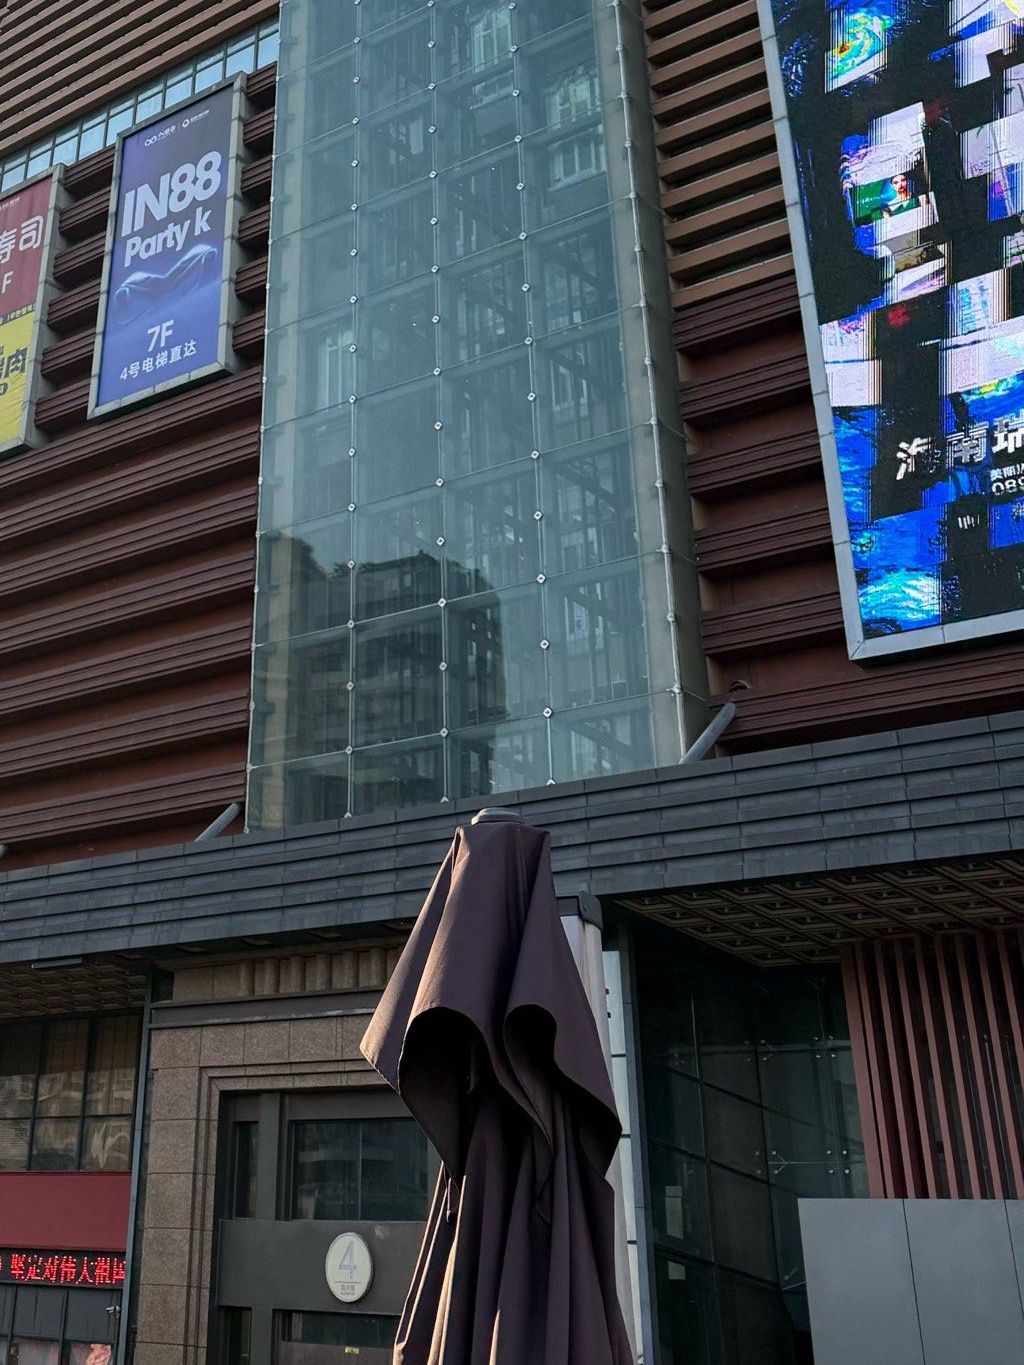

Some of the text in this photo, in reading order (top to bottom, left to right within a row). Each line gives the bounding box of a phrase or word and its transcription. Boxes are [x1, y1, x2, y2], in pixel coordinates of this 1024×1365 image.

[122, 151, 221, 237] IN88
[124, 206, 212, 268] Party k
[147, 319, 175, 352] 7F
[120, 339, 197, 380] 4号电梯直达
[339, 1241, 357, 1279] 4
